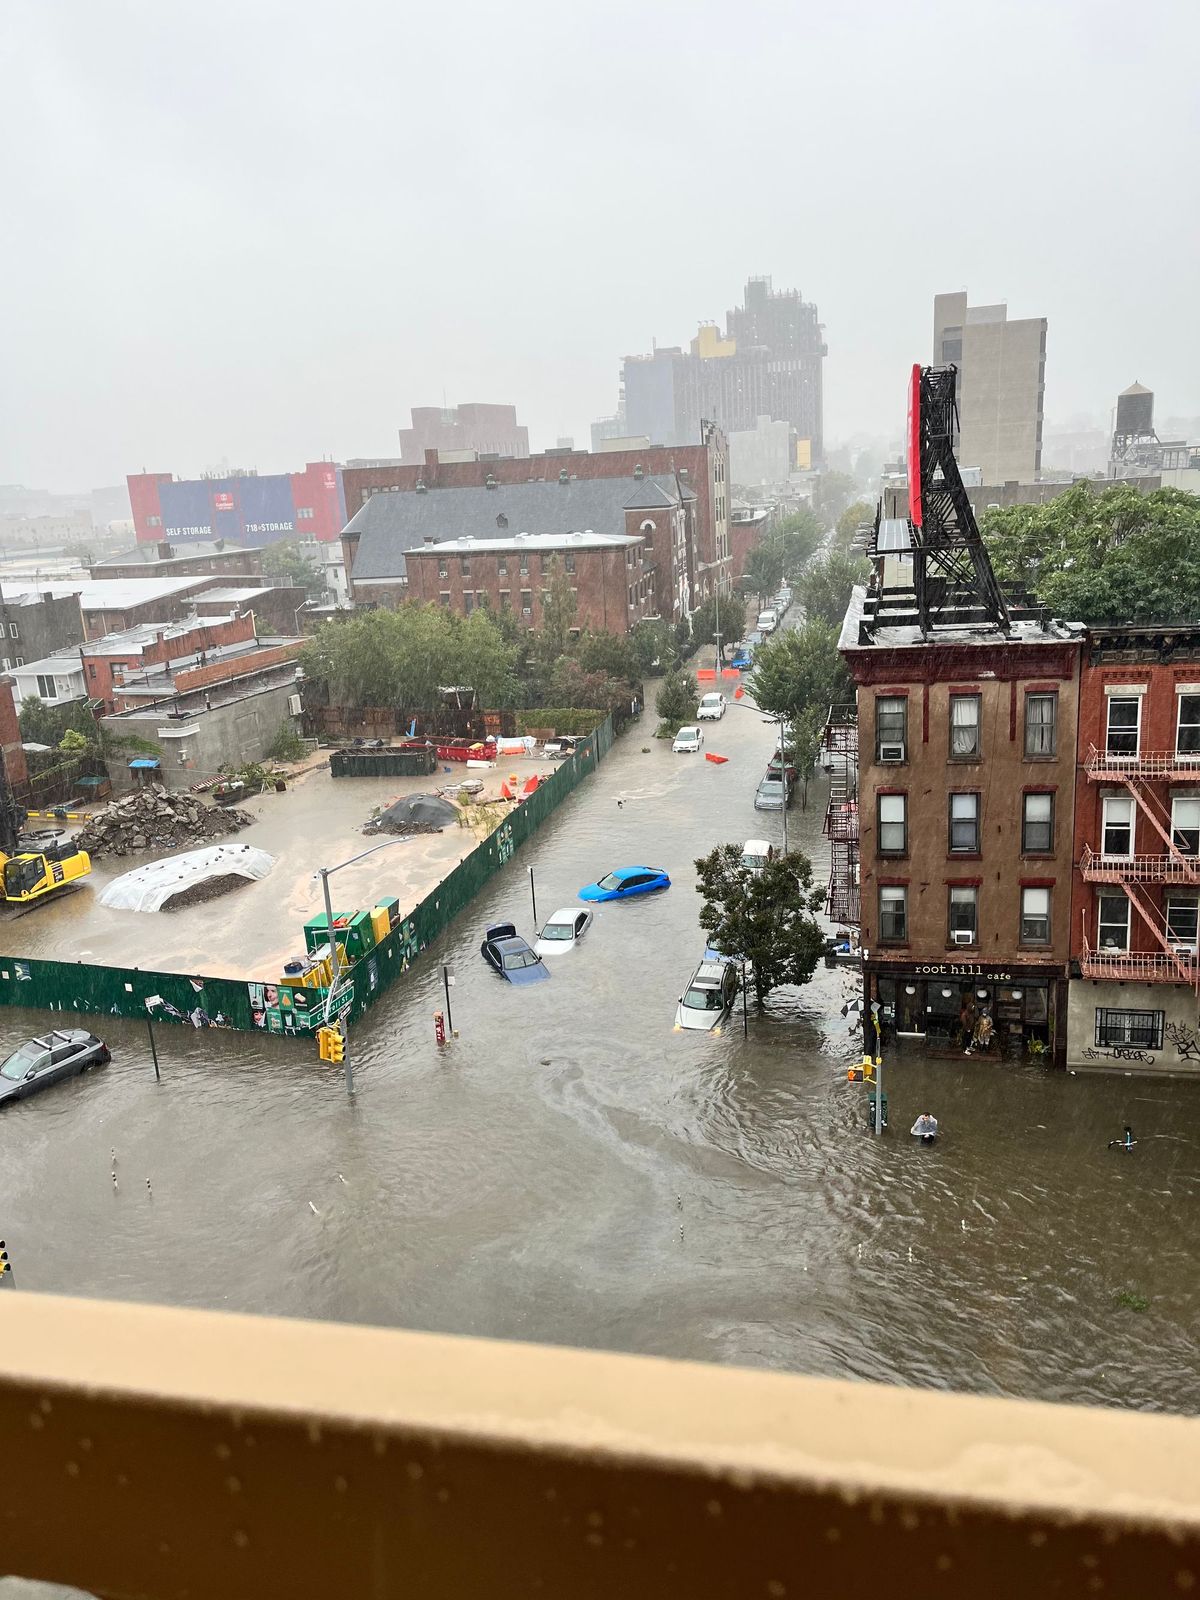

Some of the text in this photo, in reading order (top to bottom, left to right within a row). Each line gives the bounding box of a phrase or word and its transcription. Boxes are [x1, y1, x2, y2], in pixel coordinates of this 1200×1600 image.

[166, 526, 212, 536] SELF STORAGE
[915, 965, 947, 974] root
[950, 965, 983, 975] hill
[317, 1000, 341, 1021] Croll
[341, 995, 348, 1004] St
